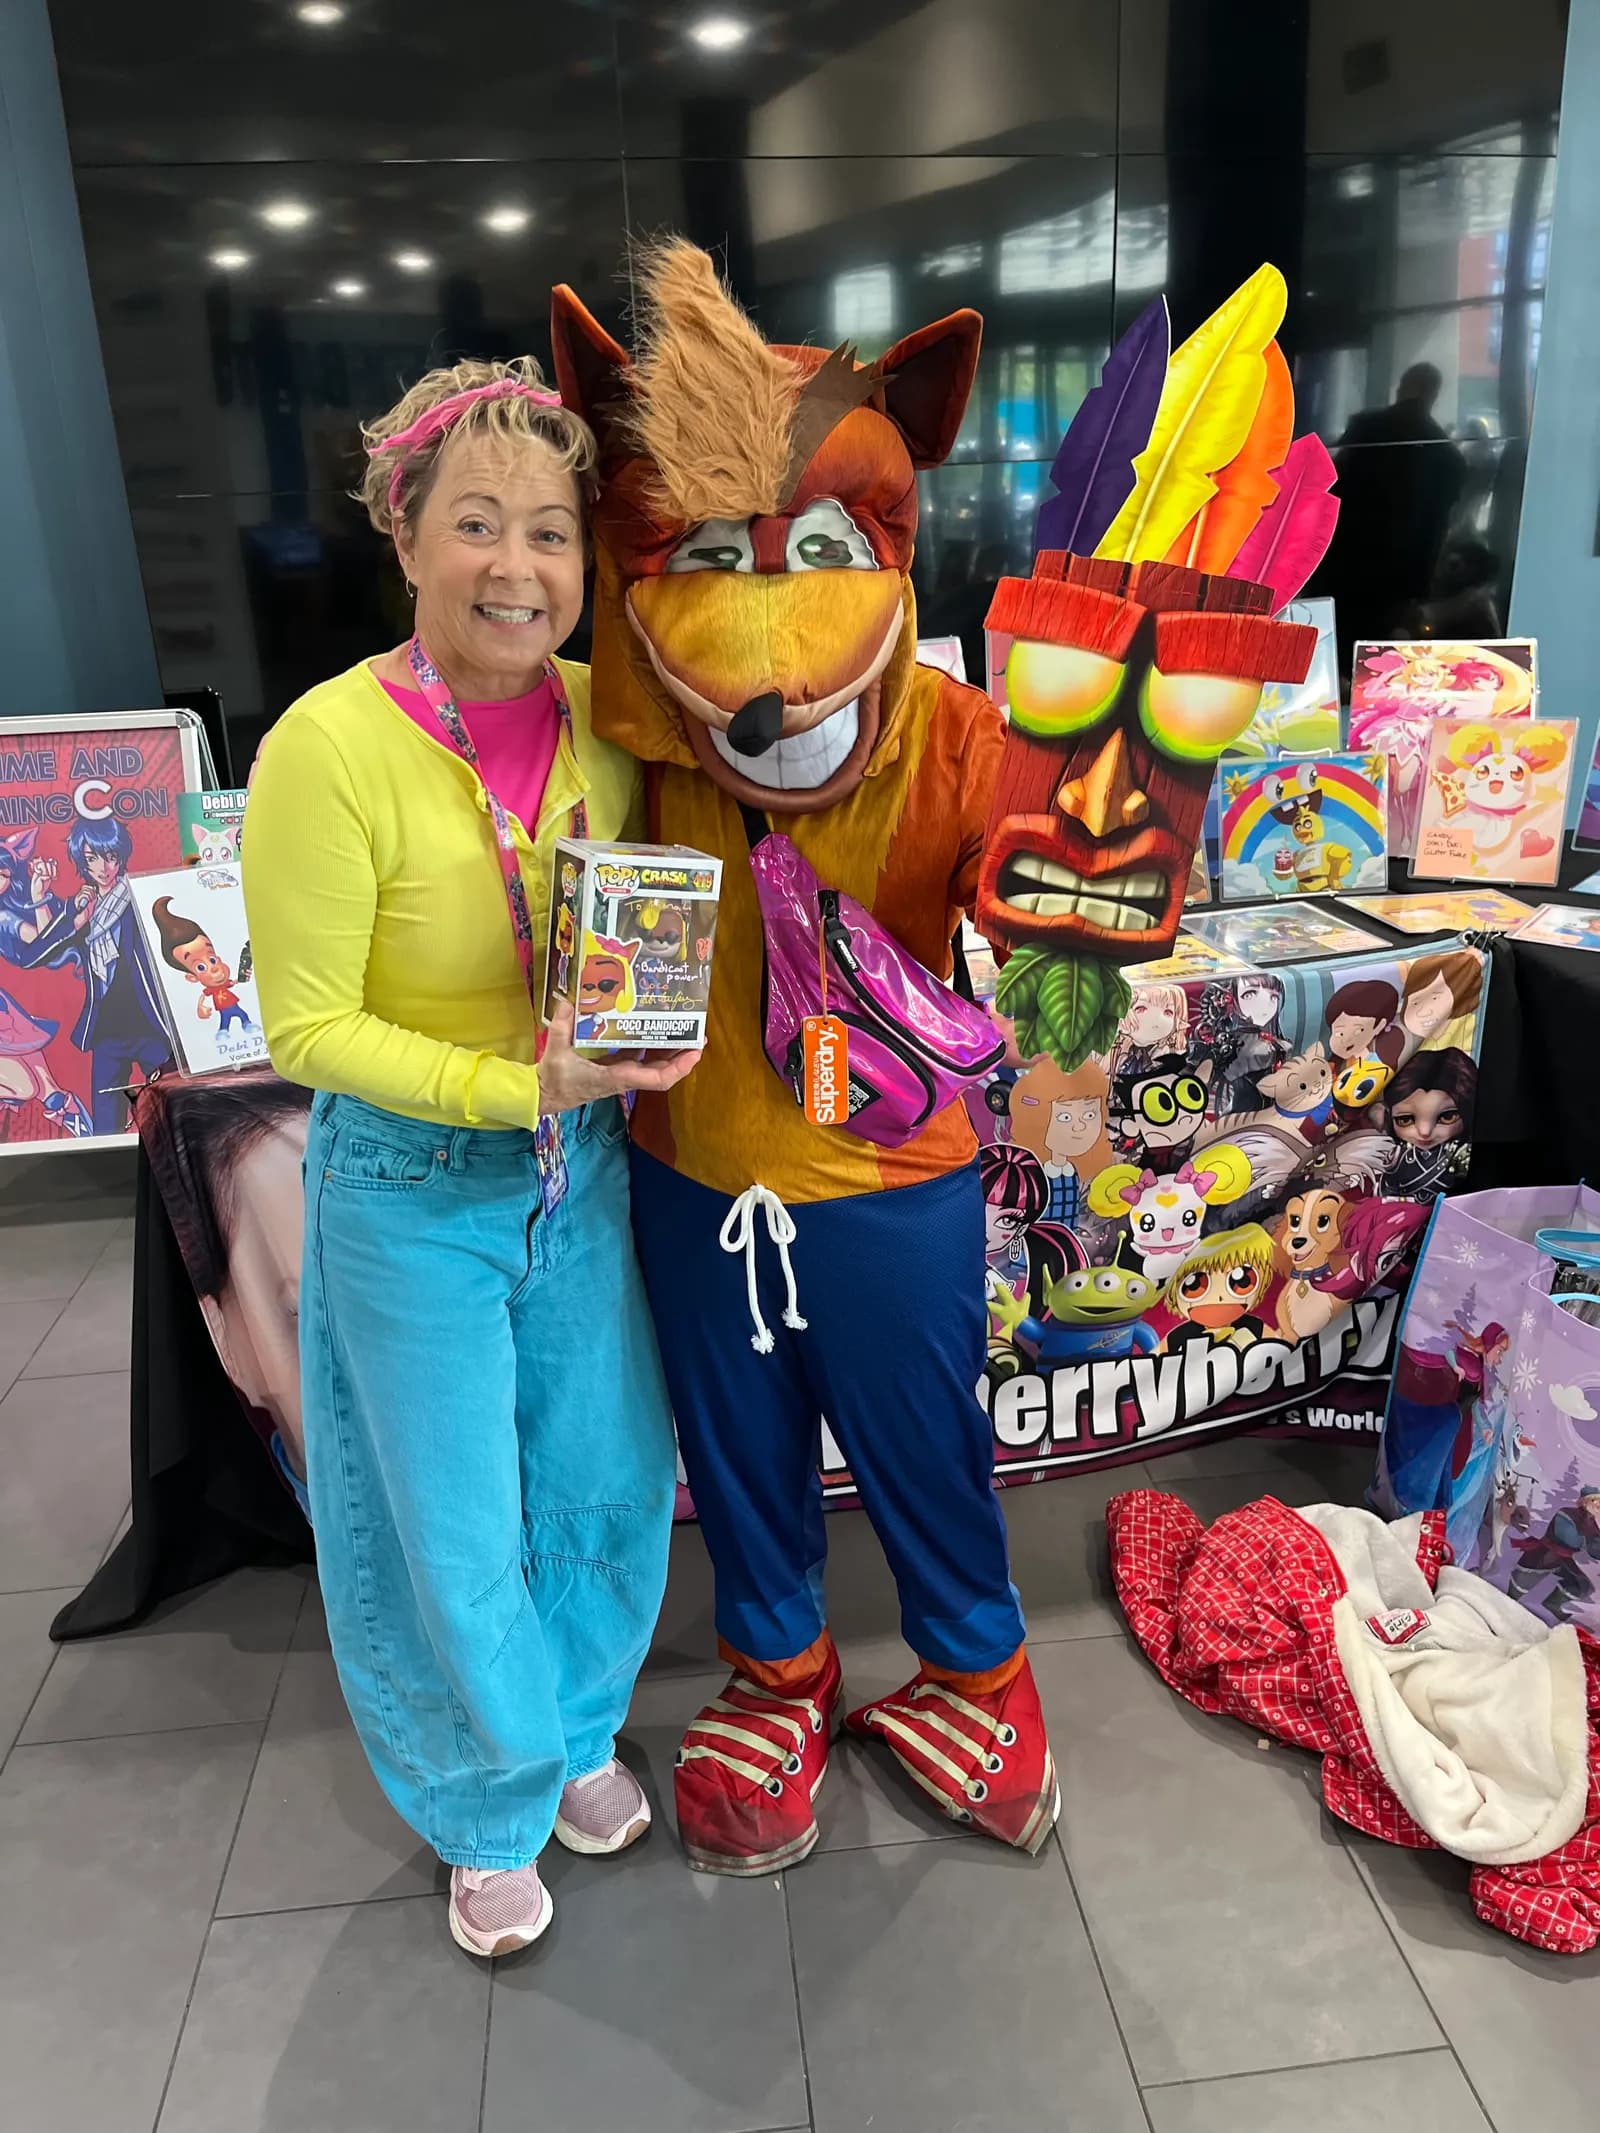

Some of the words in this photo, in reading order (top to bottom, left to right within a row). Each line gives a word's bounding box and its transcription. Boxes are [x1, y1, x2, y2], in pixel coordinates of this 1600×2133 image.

[70, 747, 143, 779] AND
[202, 793, 233, 810] Debi
[594, 864, 640, 887] POP!
[641, 869, 687, 885] CRASH
[616, 1020, 642, 1031] COCO
[643, 1020, 696, 1031] BANDICOOT
[216, 1040, 249, 1055] Debi
[229, 1052, 252, 1061] Voice
